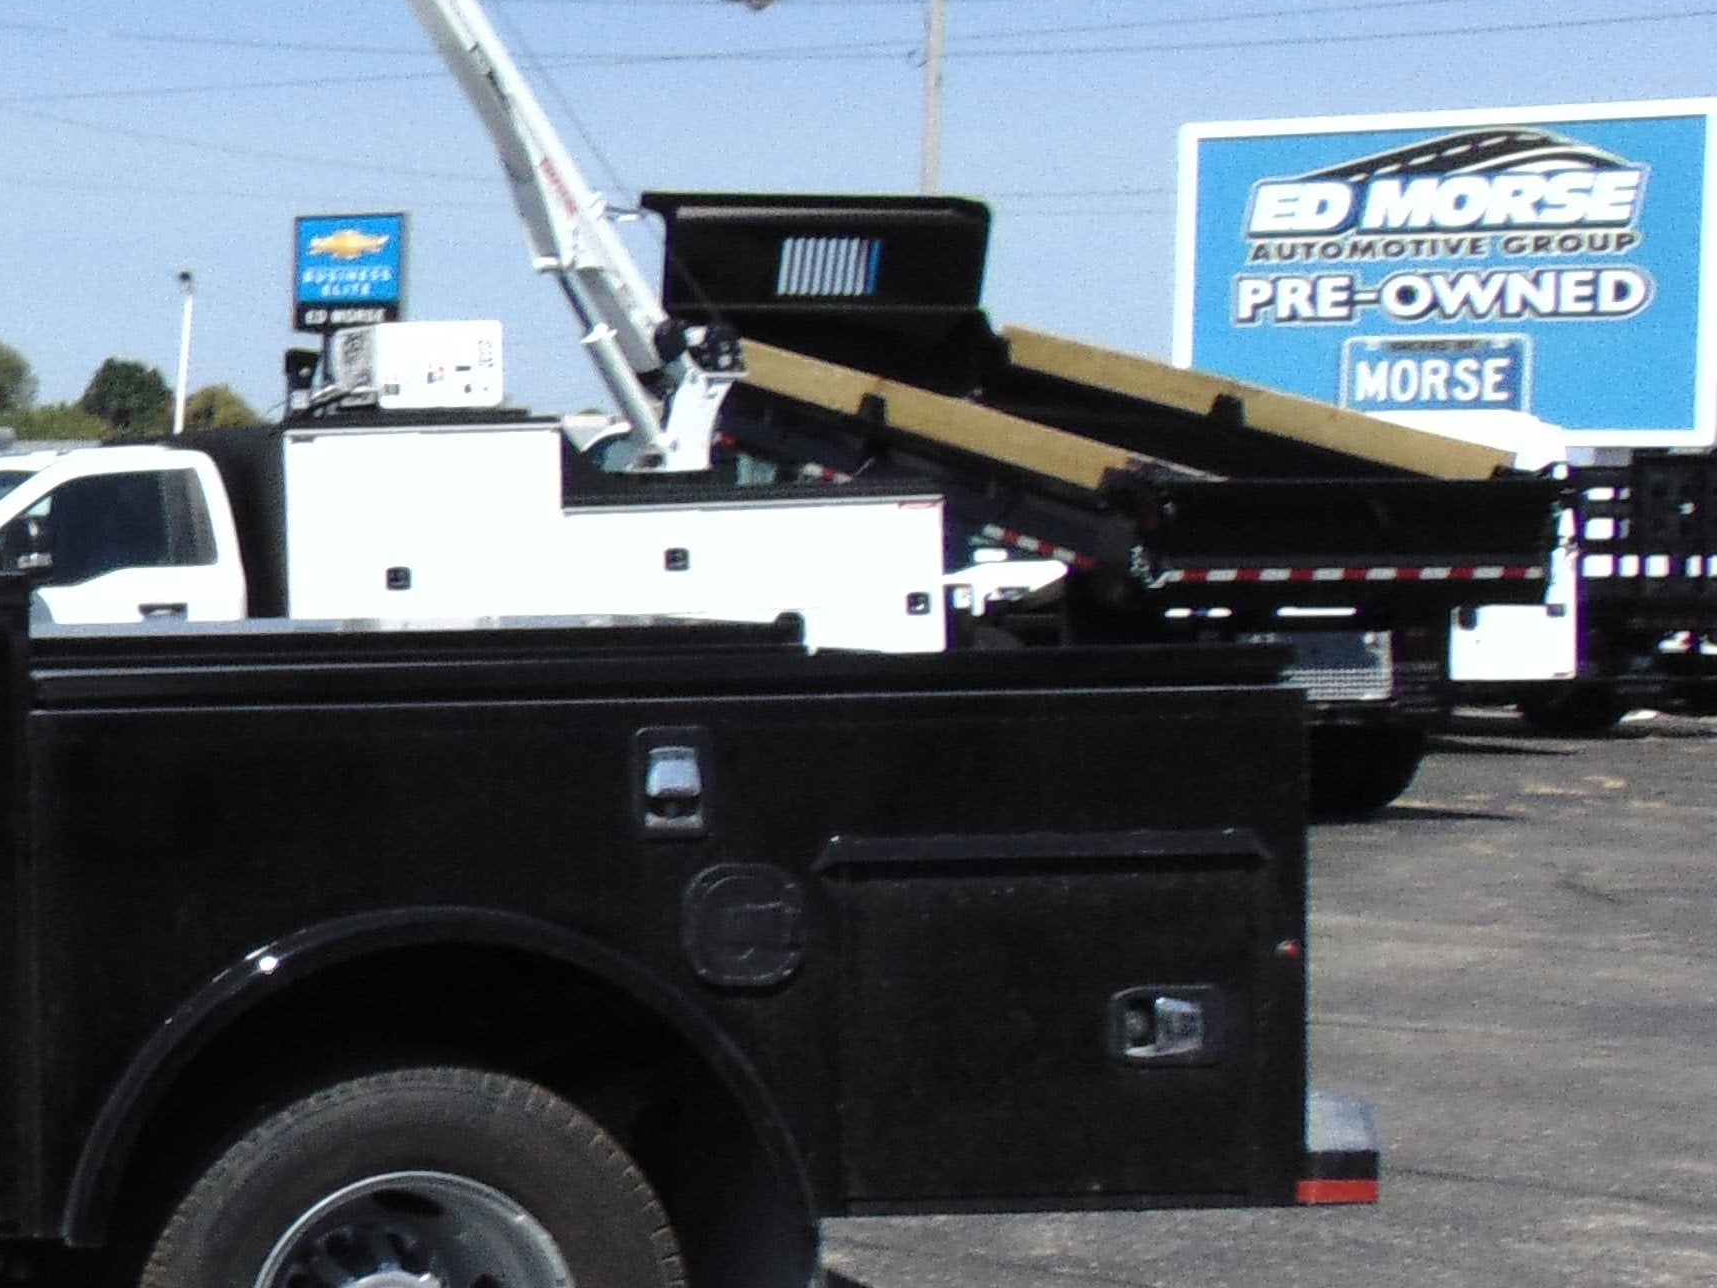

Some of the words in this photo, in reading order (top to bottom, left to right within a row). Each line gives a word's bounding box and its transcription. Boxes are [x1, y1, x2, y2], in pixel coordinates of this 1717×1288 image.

[1249, 181, 1353, 233] ED
[1362, 170, 1642, 229] MORSE
[1250, 236, 1495, 261] AUTOMOTIVE
[1501, 232, 1637, 257] GROUP
[1236, 268, 1648, 321] PRE-OWNED
[1354, 357, 1513, 403] MORSE
